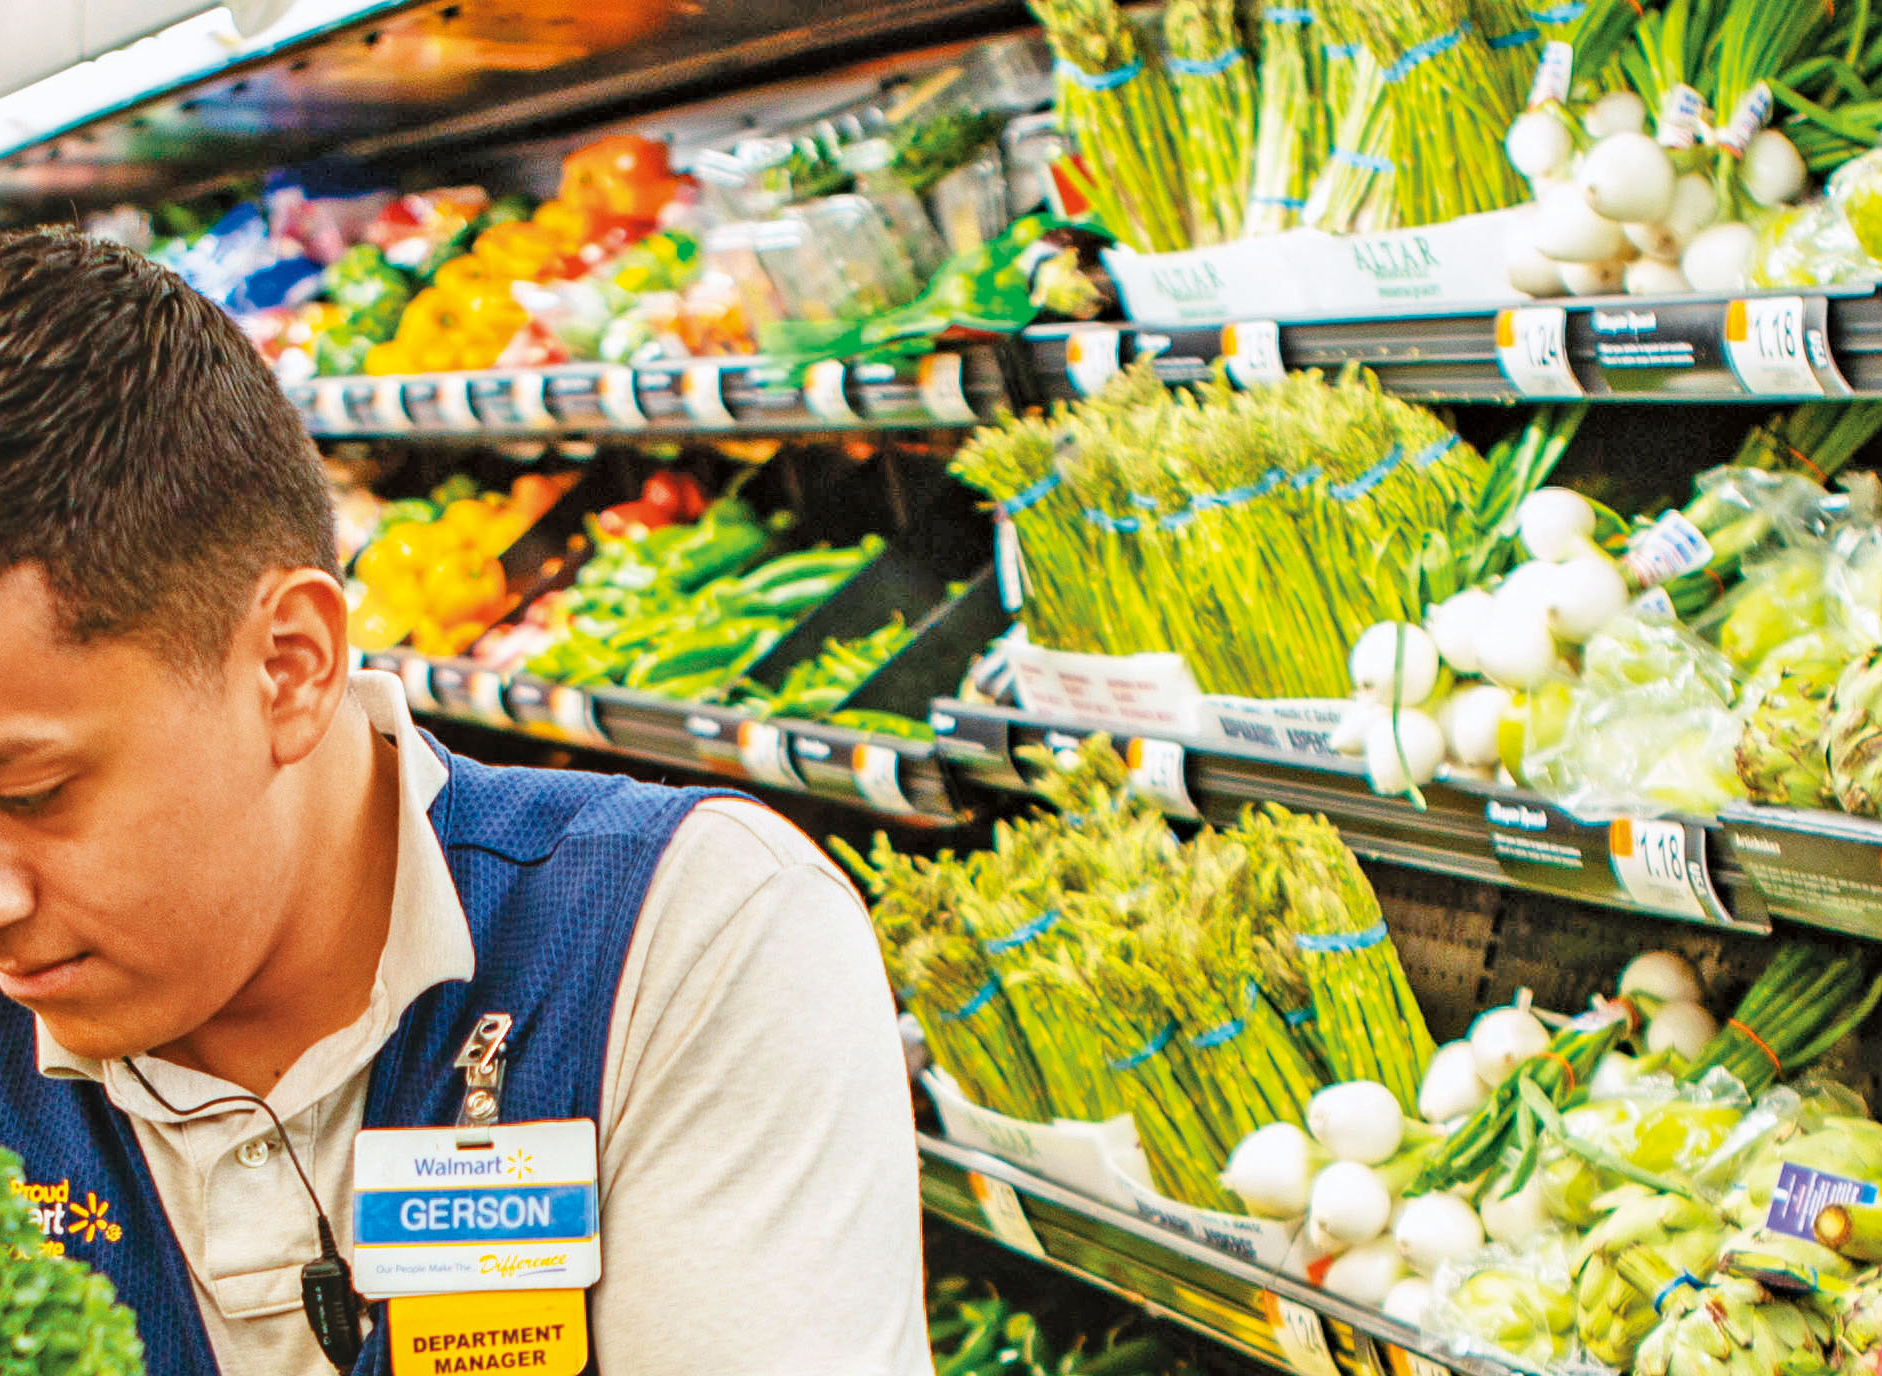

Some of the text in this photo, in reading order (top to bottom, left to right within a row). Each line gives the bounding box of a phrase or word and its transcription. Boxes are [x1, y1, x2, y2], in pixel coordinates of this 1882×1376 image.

[1352, 236, 1440, 275] ALTAR
[414, 1155, 502, 1177] Walmart
[9, 1178, 69, 1203] Proud
[399, 1194, 551, 1231] GERSON
[376, 1264, 394, 1274] Our
[396, 1263, 427, 1275] People
[428, 1262, 454, 1273] Make
[479, 1253, 568, 1278] Difference
[412, 1323, 566, 1354] DEPARTMENT
[433, 1348, 547, 1376] MANAGER
